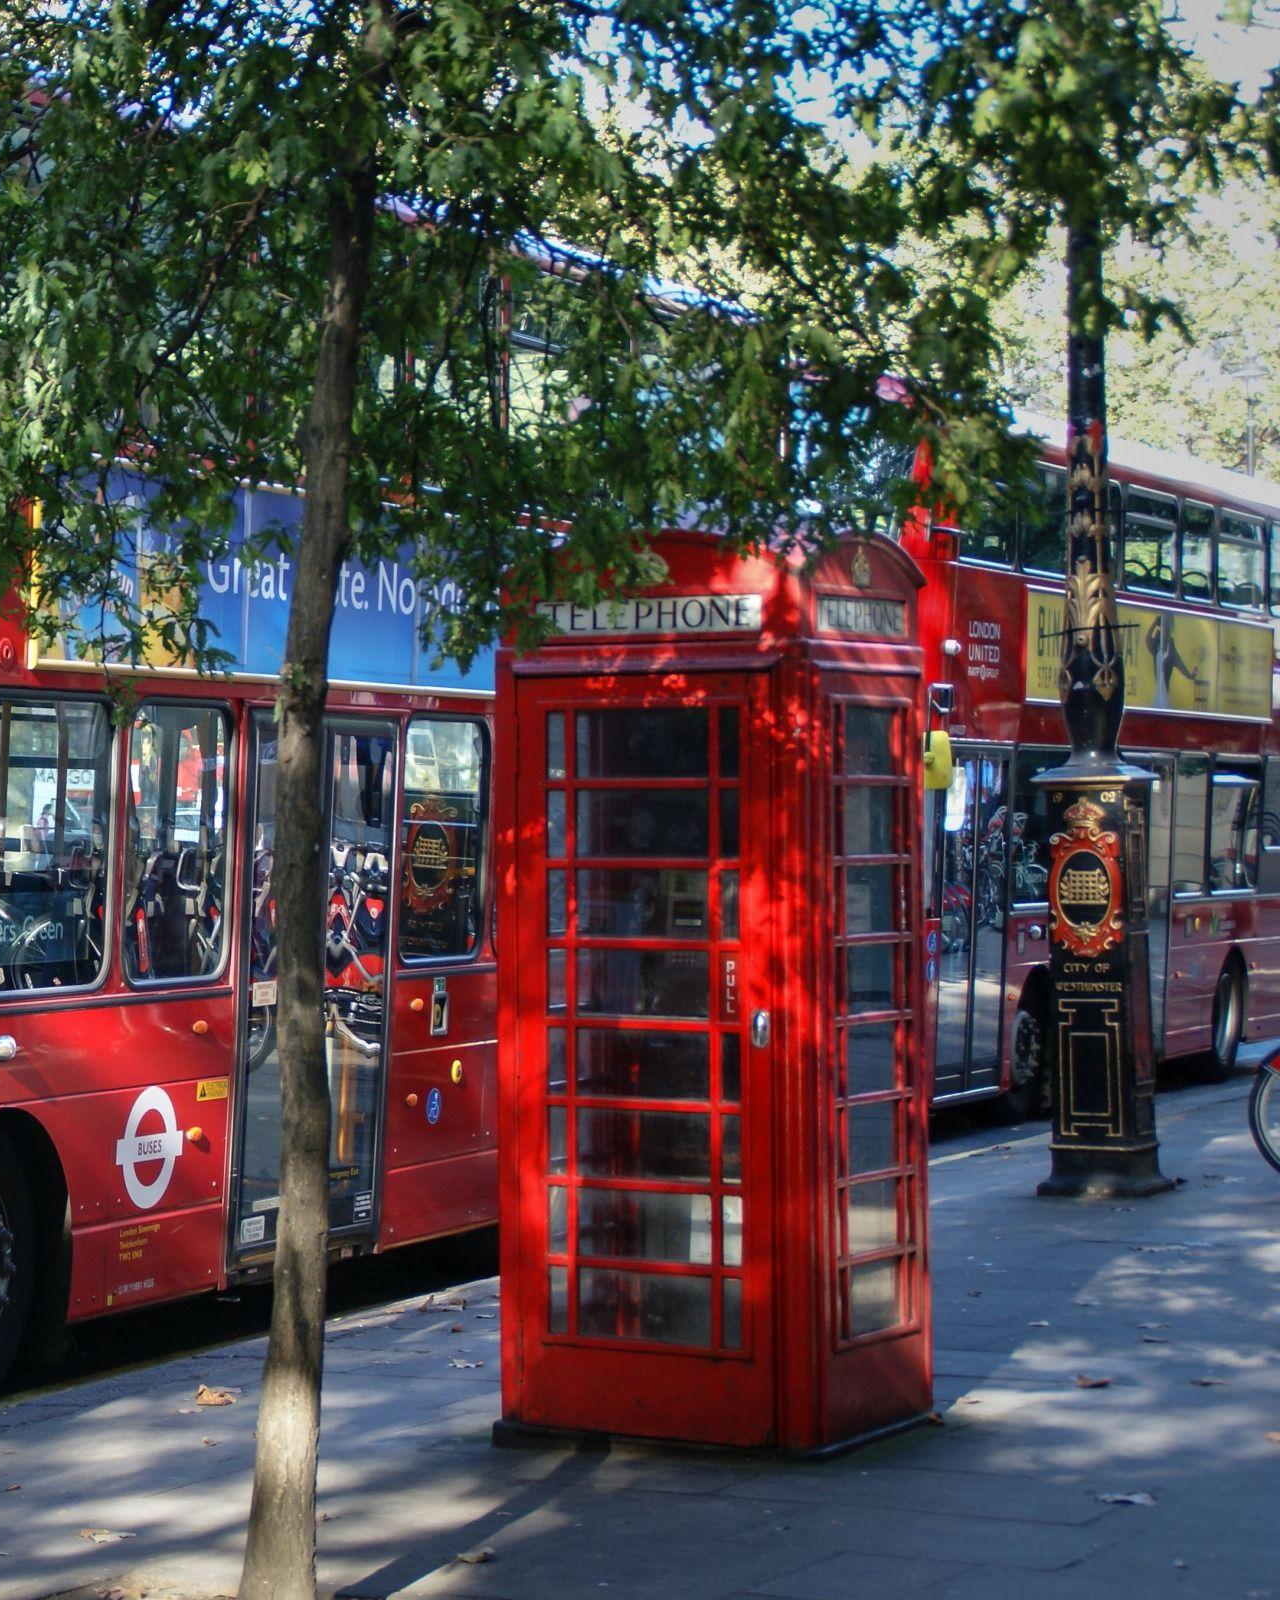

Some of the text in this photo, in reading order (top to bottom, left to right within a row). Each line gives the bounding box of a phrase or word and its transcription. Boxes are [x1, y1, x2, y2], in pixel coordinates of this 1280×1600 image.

[207, 540, 290, 601] Great
[377, 560, 416, 615] No
[549, 598, 751, 633] TELEPHONE
[818, 597, 902, 634] TELEPHONE
[968, 621, 1001, 640] LONDON
[968, 643, 1000, 663] UNITED
[33, 768, 92, 785] MAGO
[22, 915, 64, 941] Green
[1063, 963, 1110, 973] CITY OF
[726, 961, 735, 1013] PULL
[1055, 982, 1123, 992] WESTMINSTER
[137, 1139, 162, 1156] BUSES
